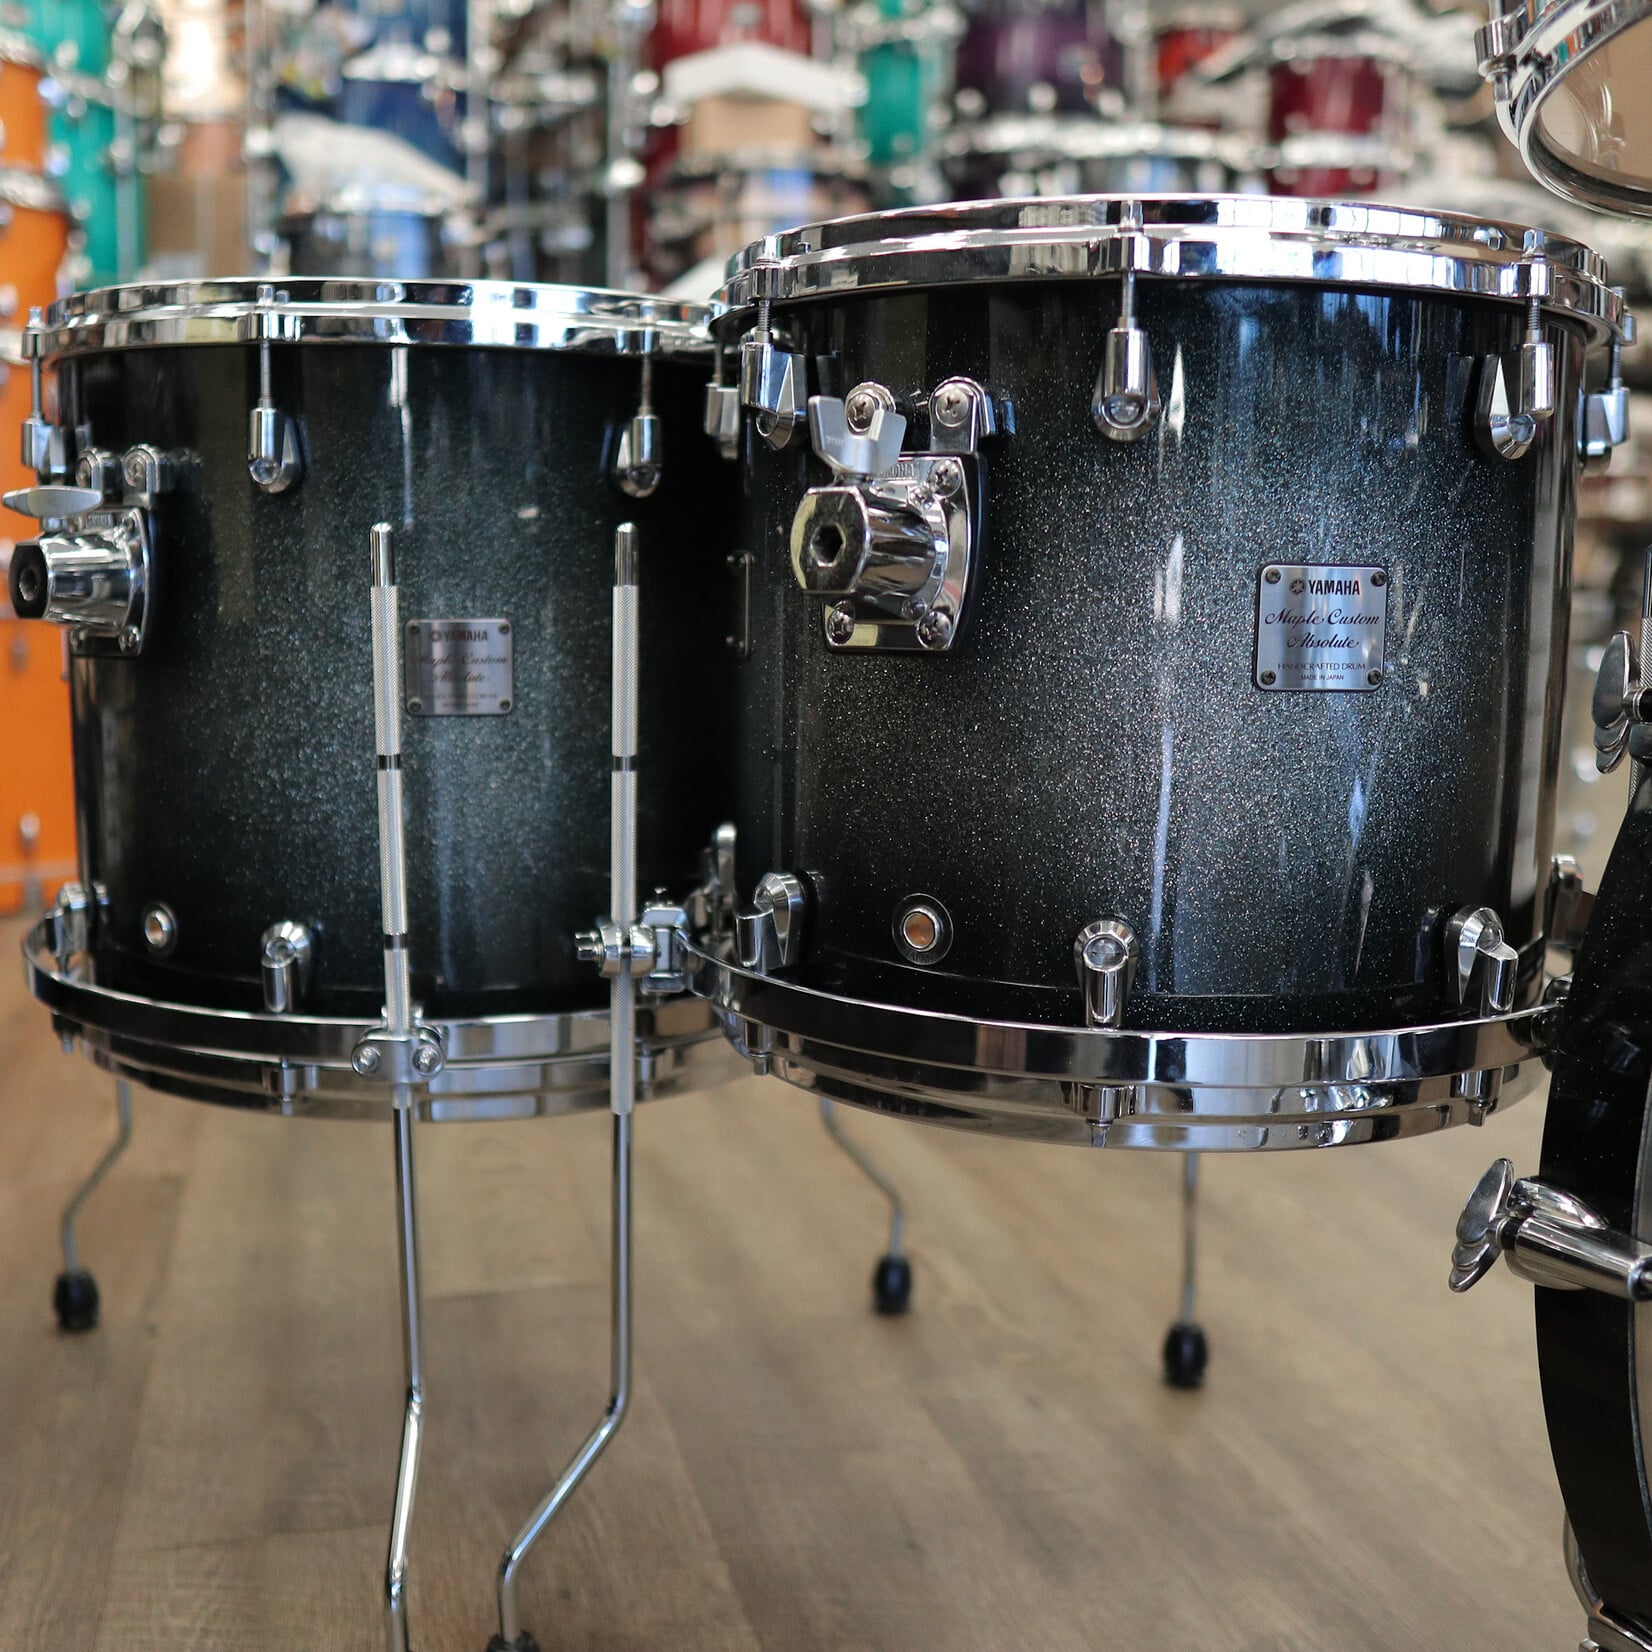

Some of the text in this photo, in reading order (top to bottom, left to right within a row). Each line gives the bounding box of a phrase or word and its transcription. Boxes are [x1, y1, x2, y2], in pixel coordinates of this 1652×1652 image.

[1308, 580, 1360, 595] YAMAHA
[1264, 608, 1380, 629] Maple Custom
[1286, 632, 1360, 649] Absolute
[1277, 662, 1340, 670] HANDCRAFTED
